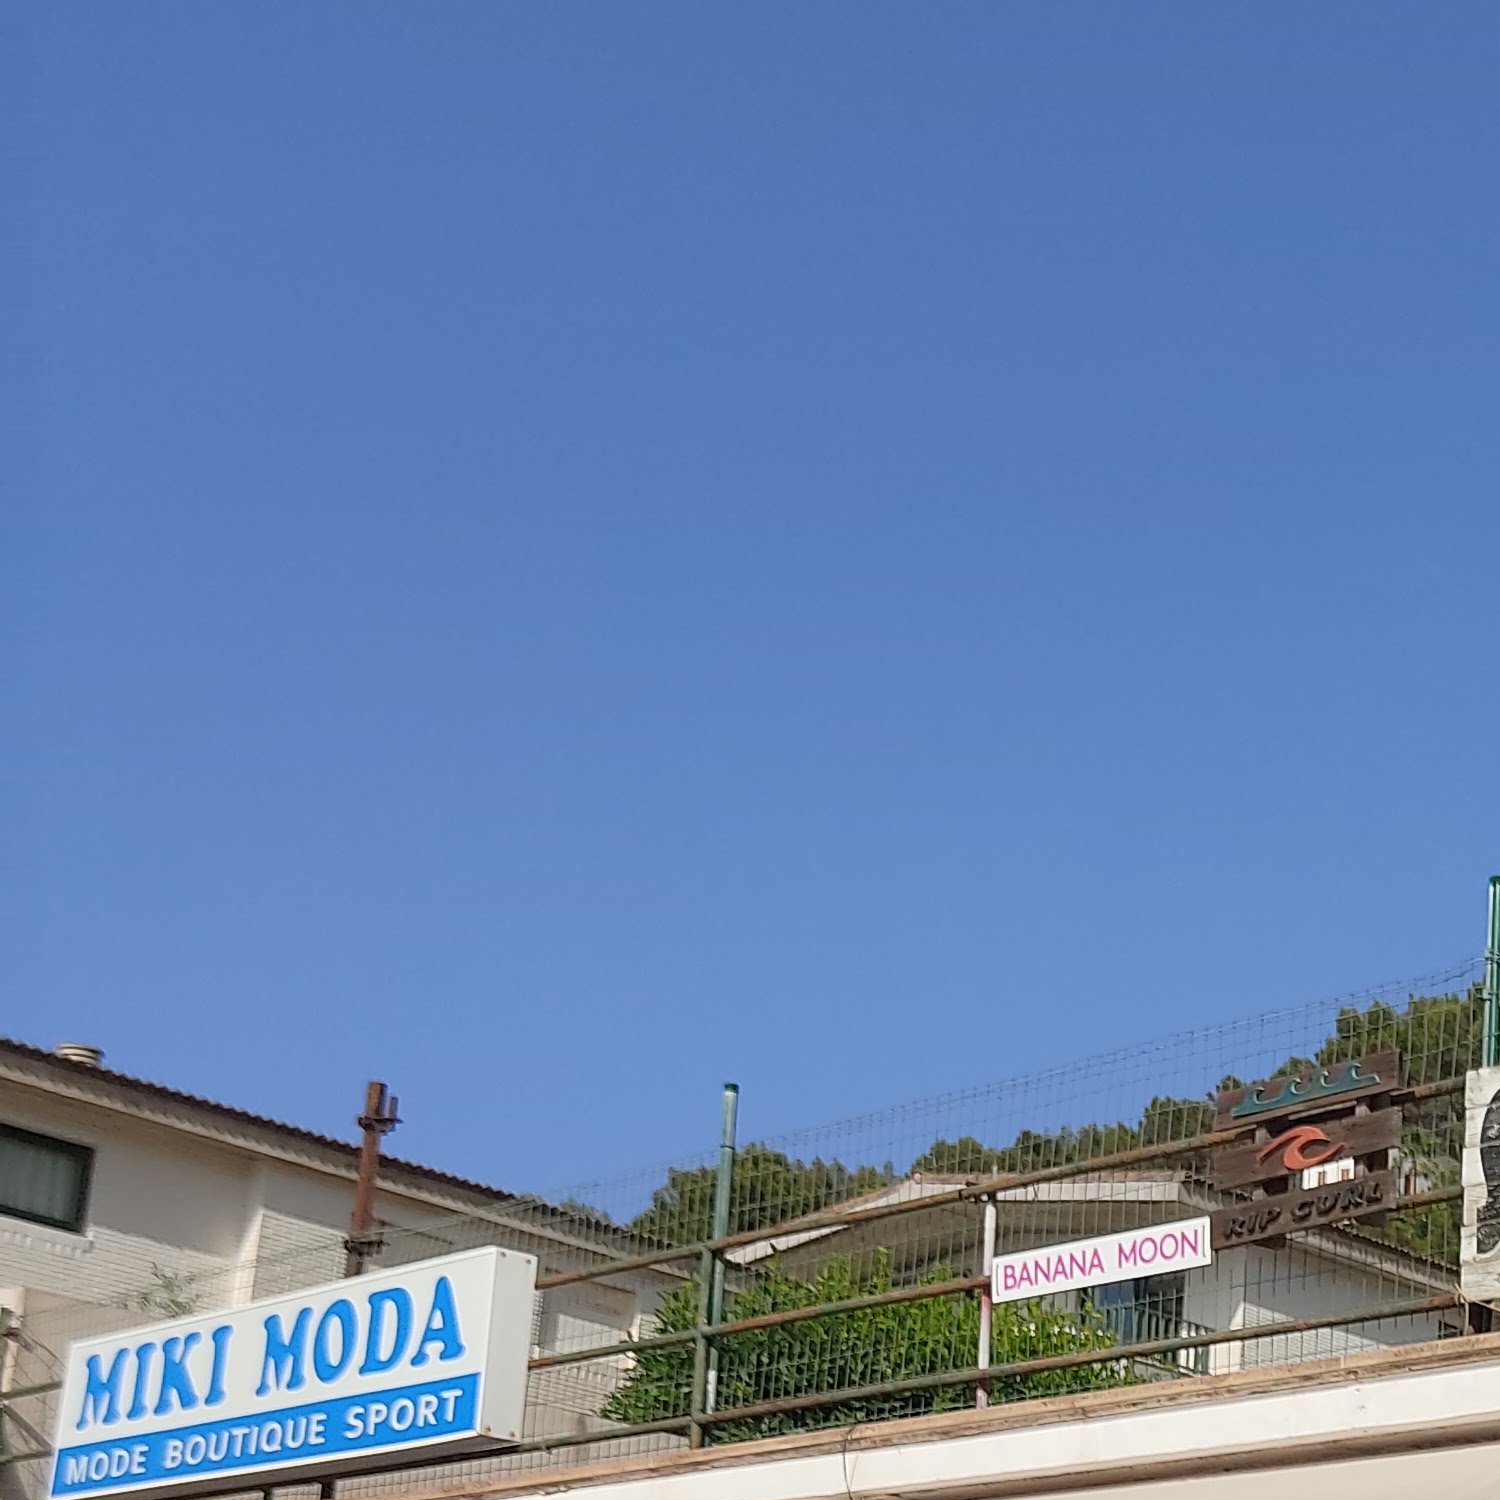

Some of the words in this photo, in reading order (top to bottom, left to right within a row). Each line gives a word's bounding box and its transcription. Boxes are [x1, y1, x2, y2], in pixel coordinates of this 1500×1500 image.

[1224, 1206, 1281, 1240] RIP
[1291, 1182, 1384, 1223] CURL
[1003, 1248, 1105, 1291] BANANA
[1117, 1229, 1199, 1269] MOON
[76, 1325, 235, 1432] MIKI
[255, 1275, 467, 1398] MODA
[64, 1444, 149, 1486] MODE
[163, 1412, 328, 1470] BOUTIQUE
[343, 1389, 464, 1440] SPORT
